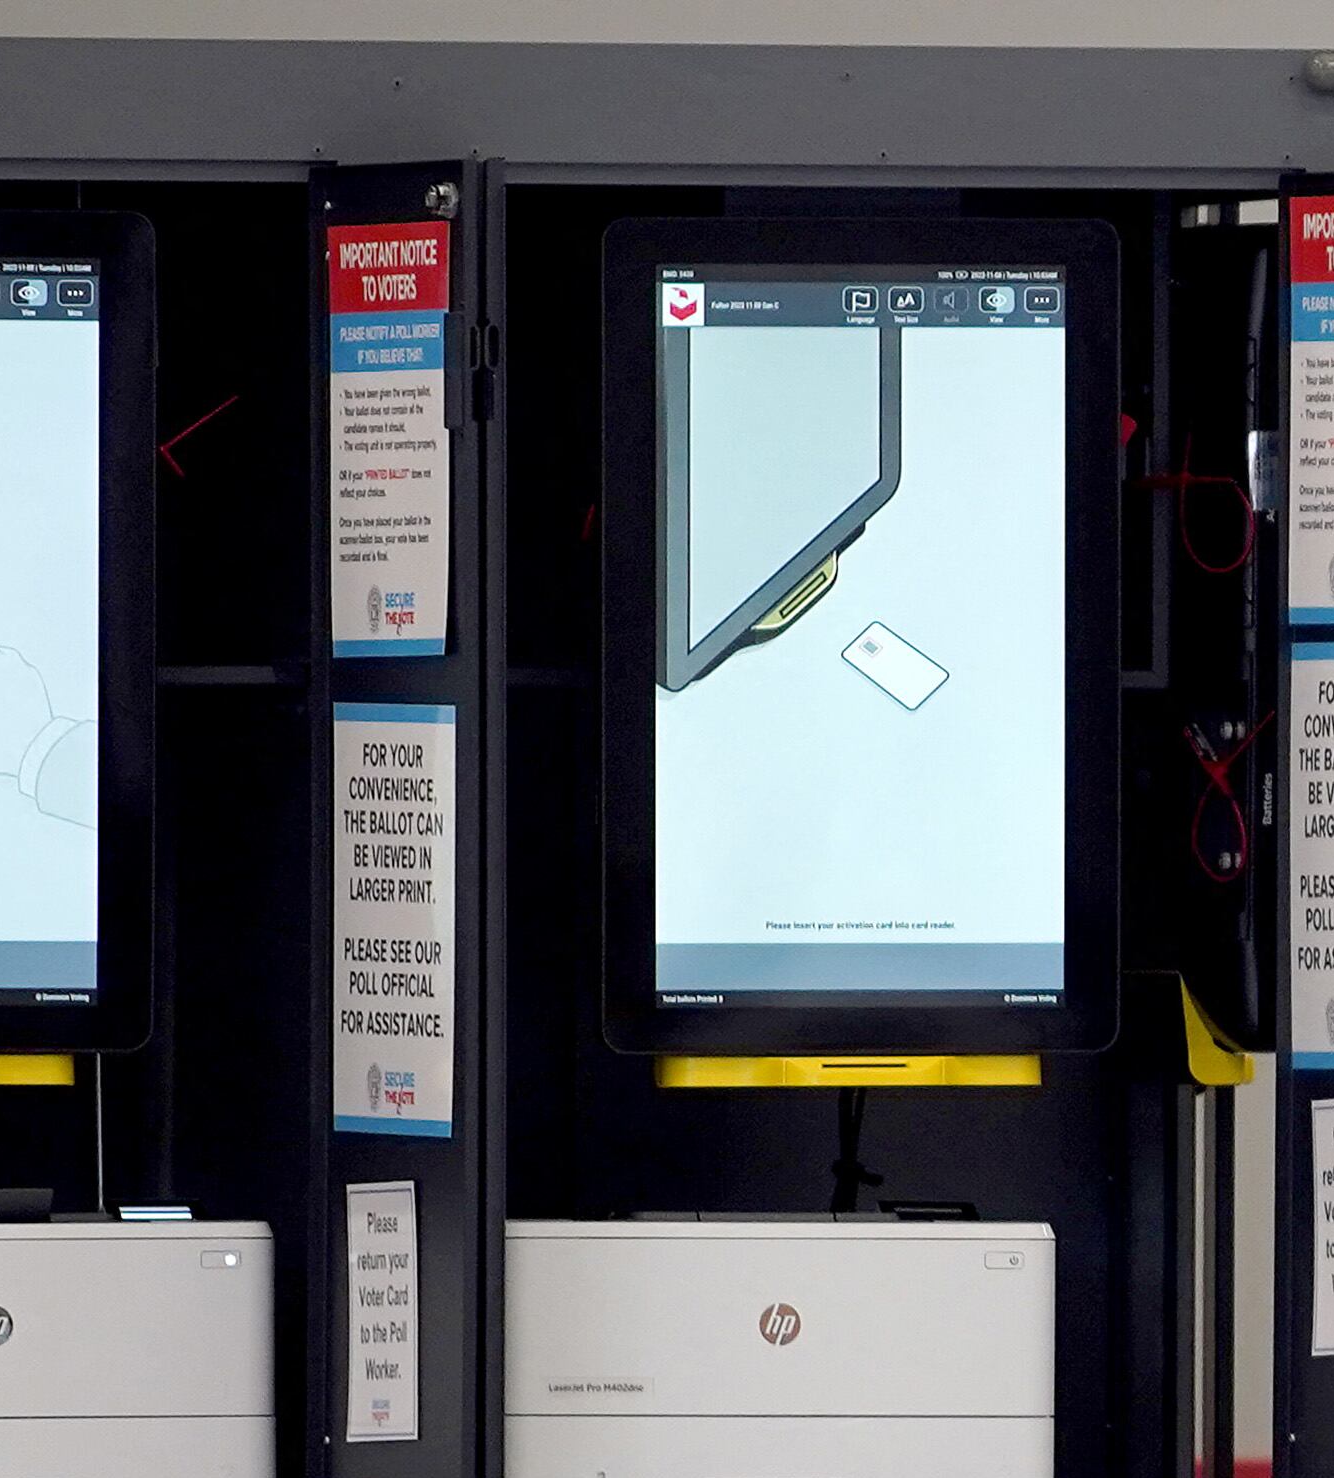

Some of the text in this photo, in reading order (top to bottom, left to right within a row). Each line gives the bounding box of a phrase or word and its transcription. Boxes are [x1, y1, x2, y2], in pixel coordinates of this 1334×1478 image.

[339, 239, 437, 268] IMPORTANT NOTICE
[362, 274, 416, 301] TO VOTERS
[363, 743, 422, 767] FOR YOUR
[1299, 748, 1320, 771] THE
[349, 777, 435, 804] CONVENIENCE,
[1262, 772, 1273, 826] Batteries
[1308, 781, 1322, 804] BE
[343, 809, 442, 835] THE BALLOT CAN
[354, 844, 431, 868] BE VIEWED IN
[350, 878, 435, 902] LARGER PRINT.
[1305, 908, 1334, 931] POLL
[344, 938, 440, 964] PLEASE SEE OUR
[1298, 946, 1320, 970] FOR
[349, 971, 434, 997] POLL OFFICIAL
[341, 1010, 444, 1036] FOR ASSISTANCE.
[367, 1212, 397, 1232] Please
[388, 1253, 408, 1274] your
[359, 1285, 407, 1306] Voter Card
[360, 1321, 406, 1343] to the Poll
[759, 1302, 801, 1346] hp
[365, 1359, 400, 1380] Worker.
